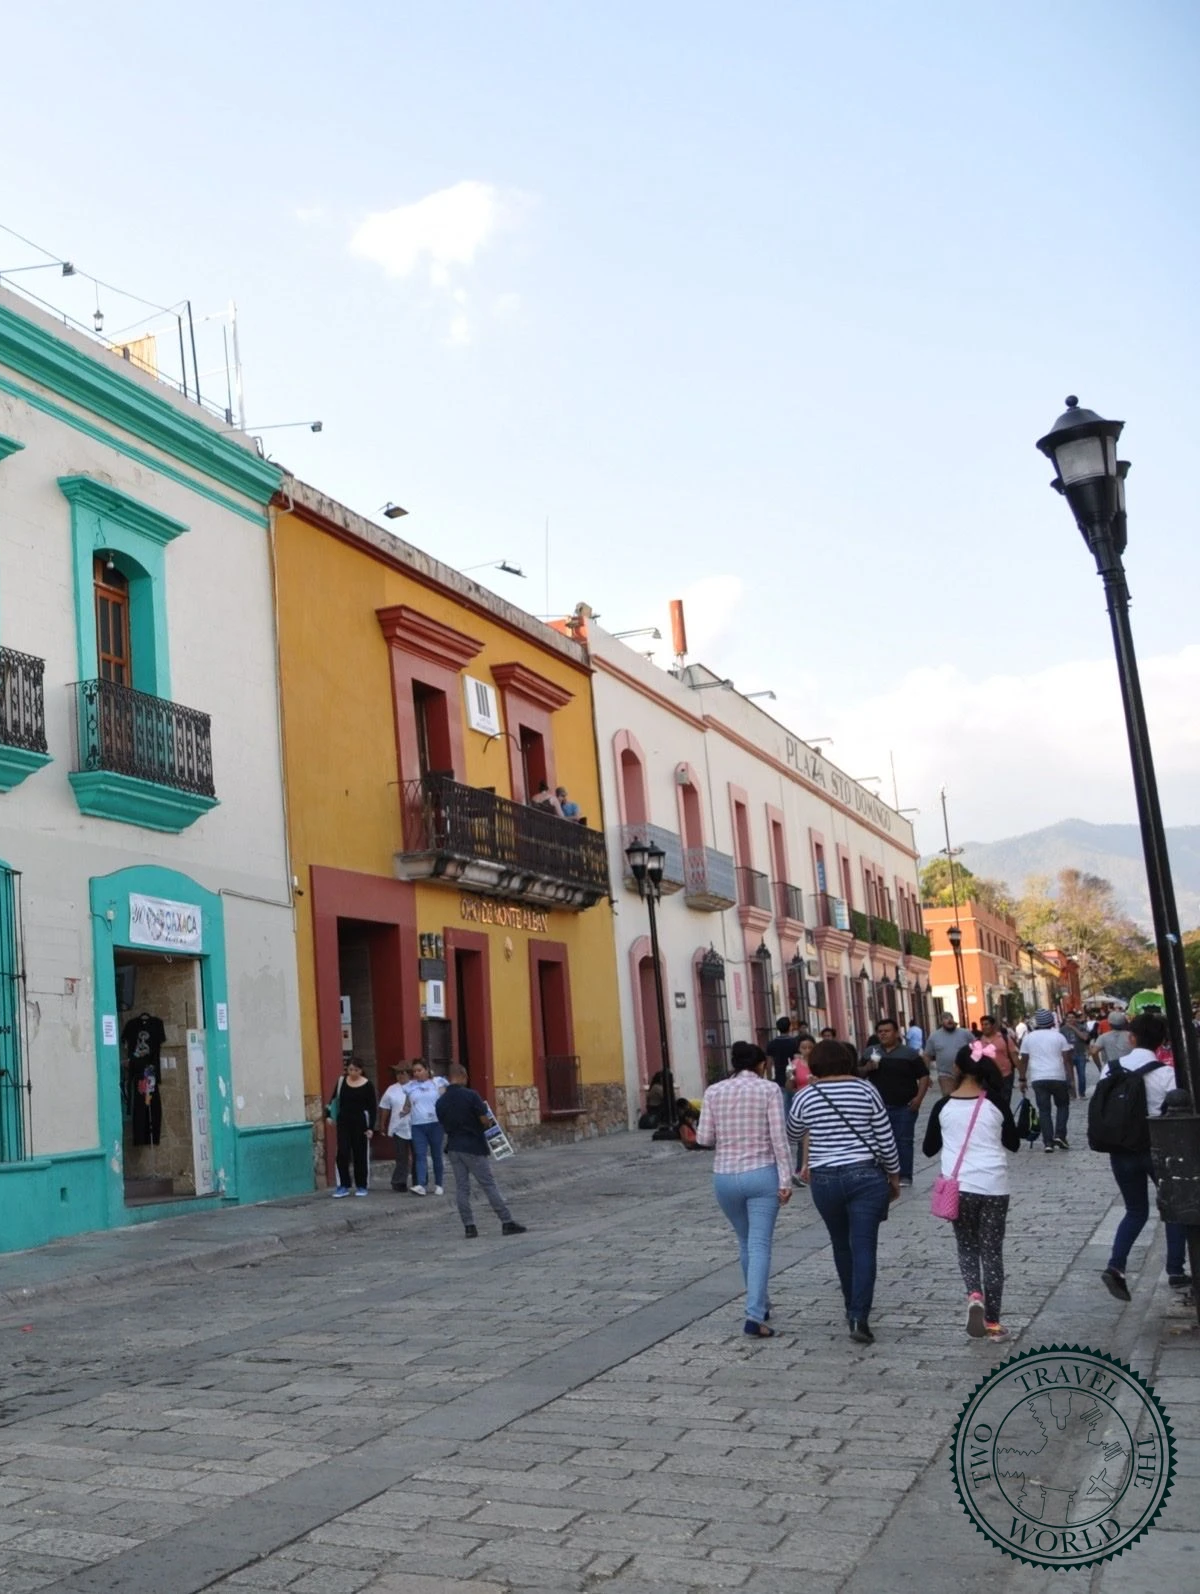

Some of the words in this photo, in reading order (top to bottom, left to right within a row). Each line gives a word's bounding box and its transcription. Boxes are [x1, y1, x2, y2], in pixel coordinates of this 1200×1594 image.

[785, 736, 827, 789] PLAZA
[855, 786, 892, 832] DOMINGO
[165, 911, 199, 935] OAXACA
[494, 905, 522, 930] MONTE
